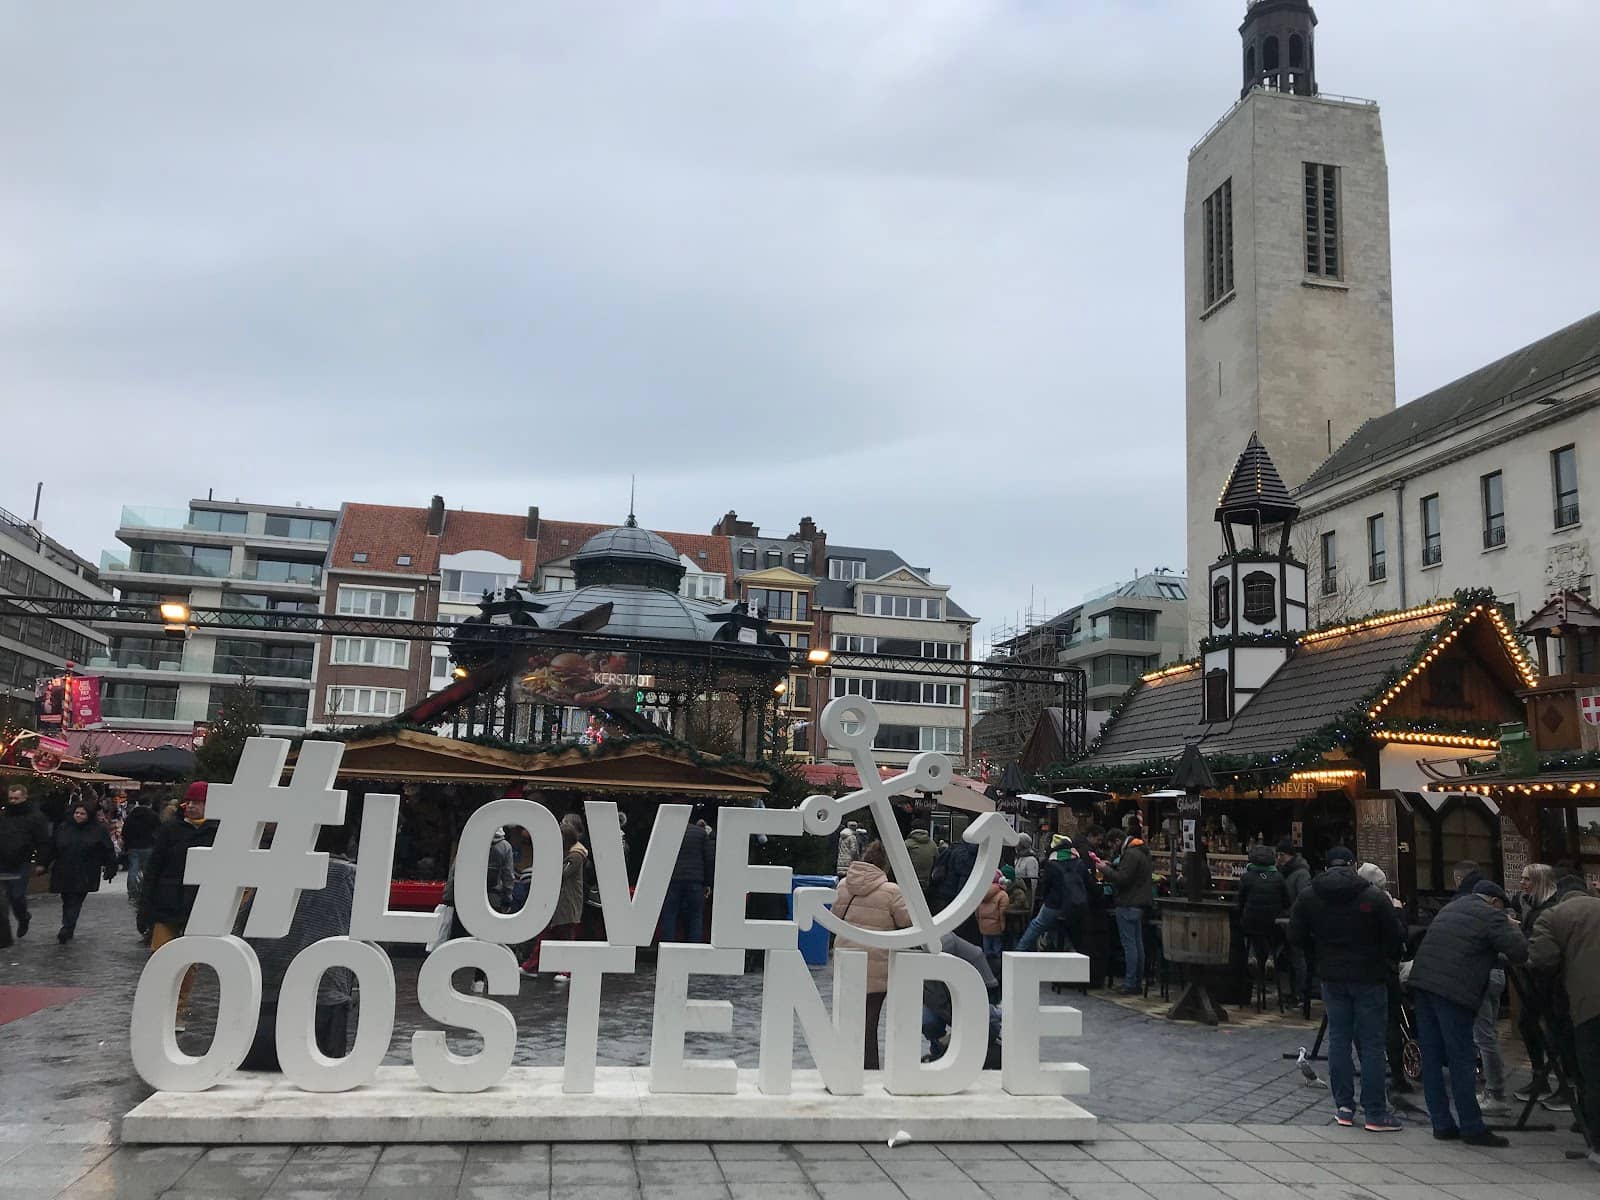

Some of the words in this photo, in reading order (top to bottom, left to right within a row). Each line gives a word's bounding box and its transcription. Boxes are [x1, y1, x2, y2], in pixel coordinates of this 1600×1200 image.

[593, 672, 653, 687] KERSTKOT
[183, 737, 804, 951] #LOVE
[130, 934, 1091, 1097] OOSTENDE
